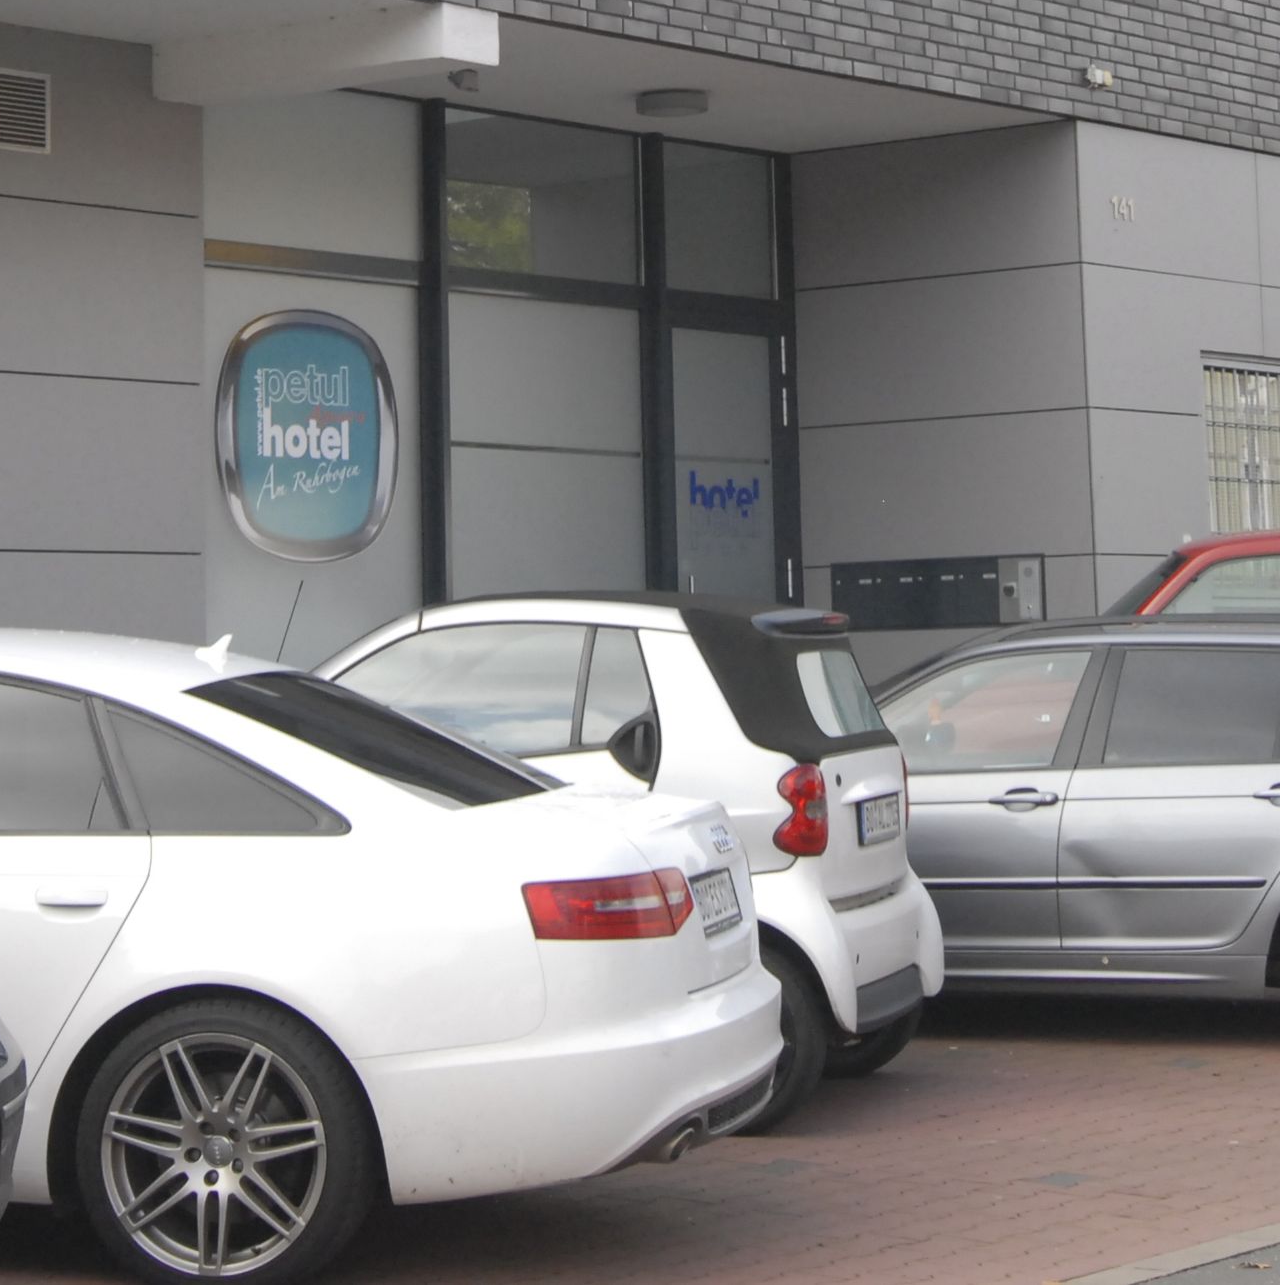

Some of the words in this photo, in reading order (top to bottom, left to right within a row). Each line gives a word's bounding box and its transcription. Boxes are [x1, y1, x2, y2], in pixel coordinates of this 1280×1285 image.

[253, 367, 263, 456] www.petul.de
[261, 363, 350, 407] petul
[262, 406, 350, 461] hotel
[256, 463, 287, 511] Am
[292, 457, 361, 495] Ruhrbogen
